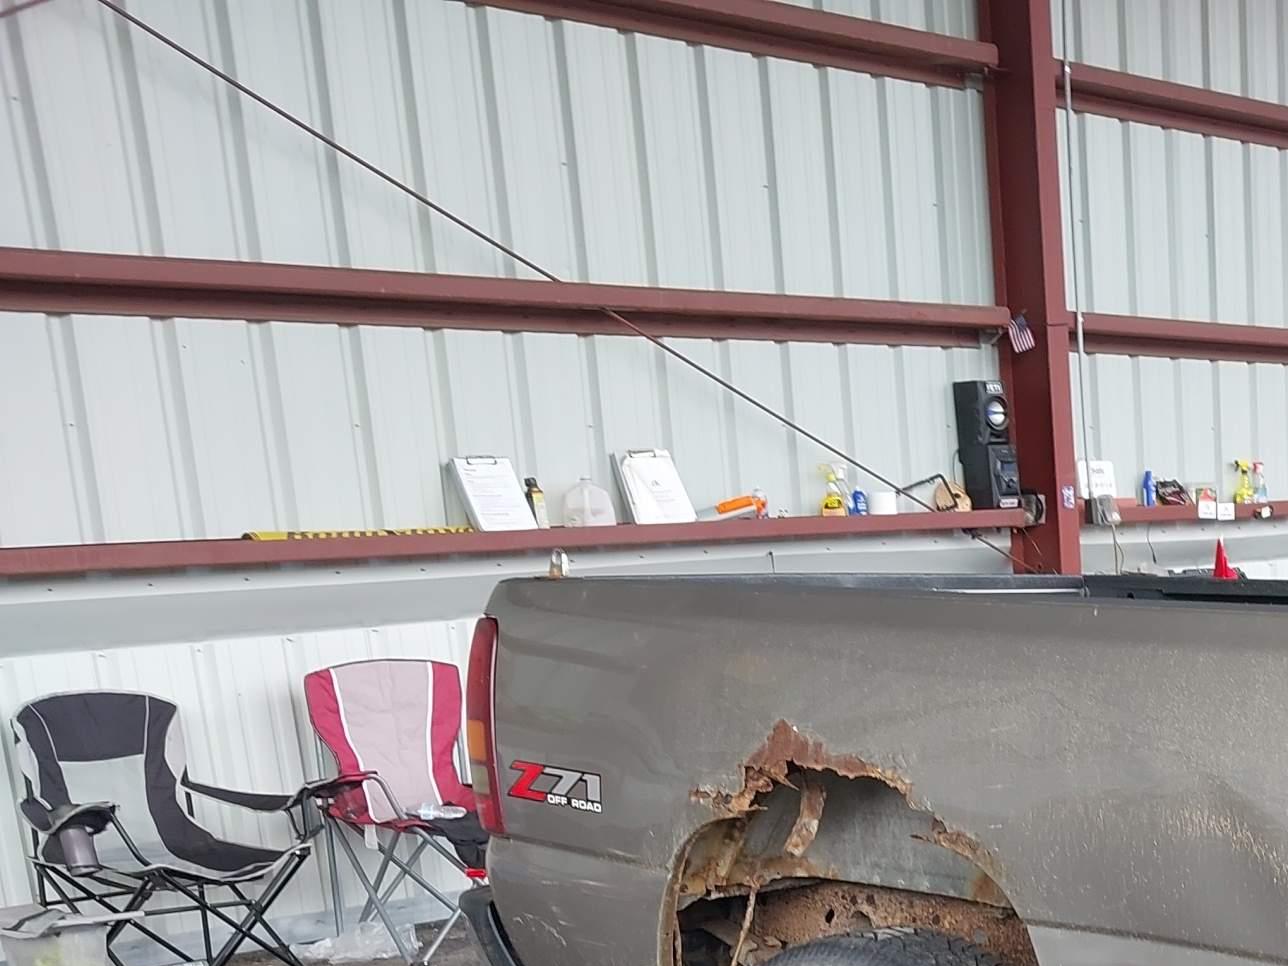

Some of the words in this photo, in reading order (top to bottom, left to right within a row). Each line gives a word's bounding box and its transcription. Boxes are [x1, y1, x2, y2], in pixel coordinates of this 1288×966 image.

[508, 761, 602, 802] Z71
[547, 795, 568, 807] OFF
[571, 799, 602, 813] ROAD
